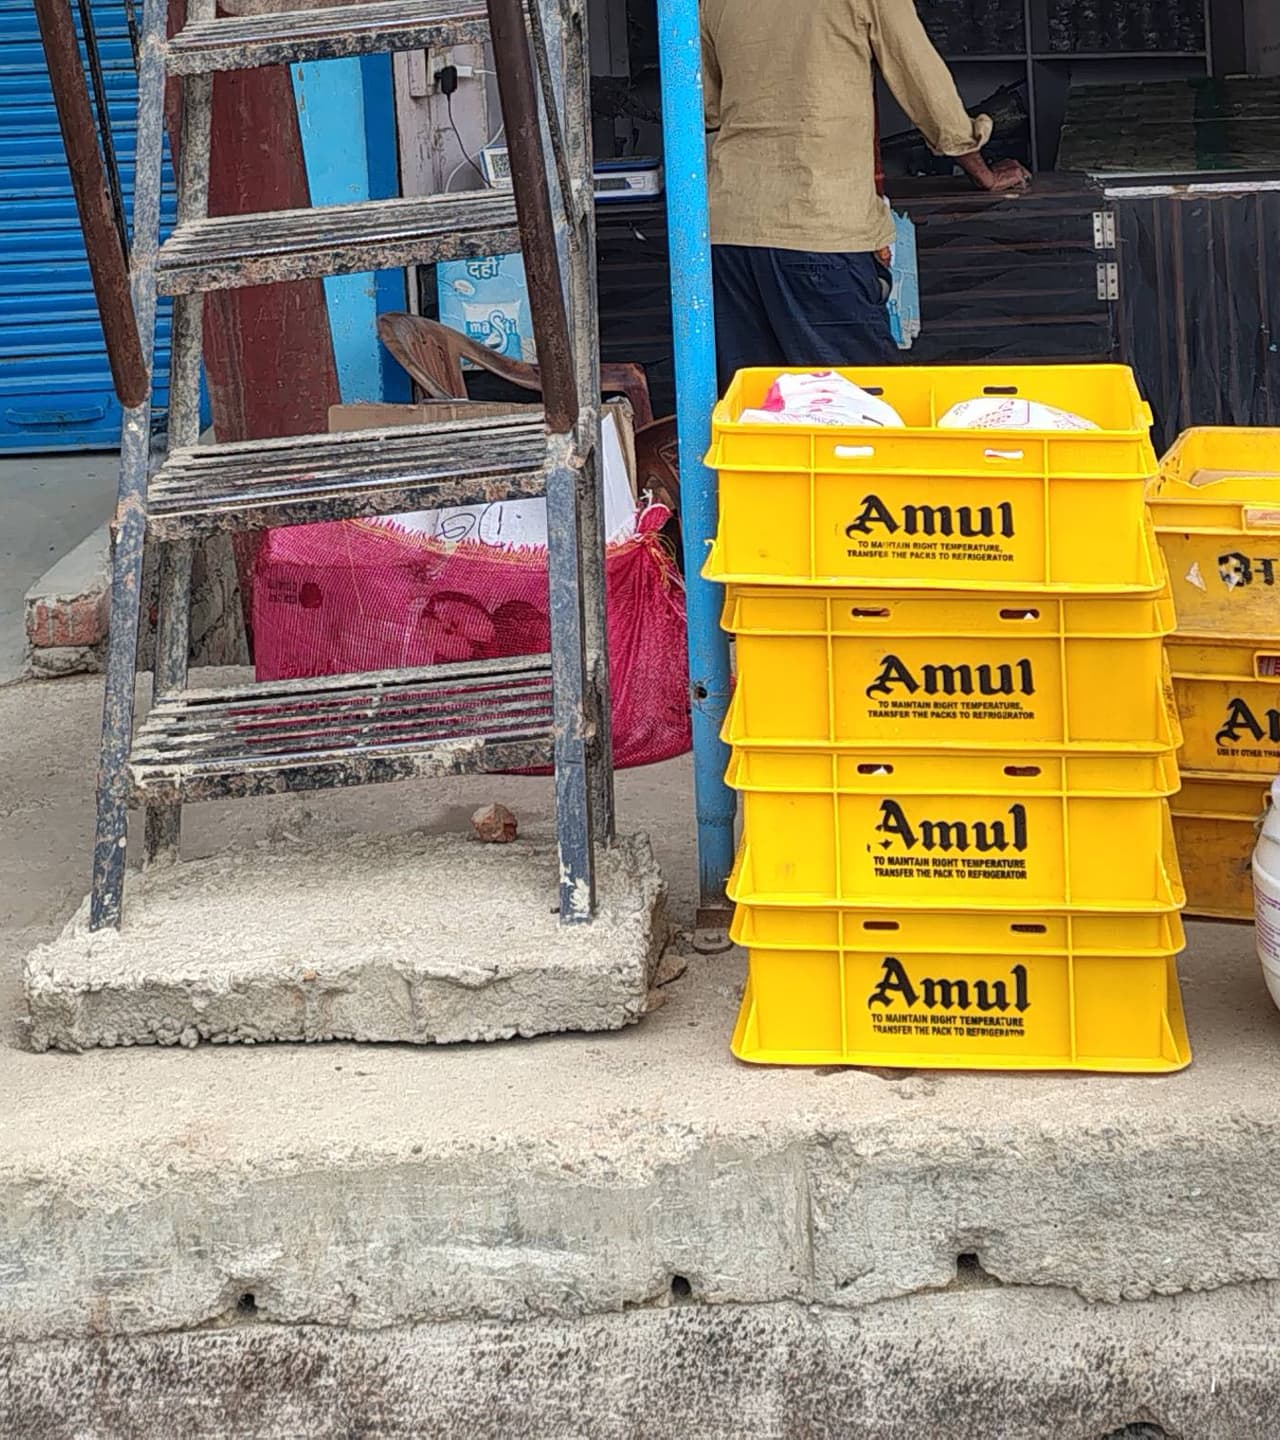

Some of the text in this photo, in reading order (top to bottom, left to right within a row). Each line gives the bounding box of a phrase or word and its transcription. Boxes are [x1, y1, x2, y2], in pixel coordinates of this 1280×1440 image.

[845, 494, 1015, 539] Amul
[858, 540, 869, 548] TO
[913, 542, 938, 550] RIGHT
[892, 550, 907, 558] THE
[910, 551, 936, 559] PACKS
[939, 552, 950, 560] TO
[952, 553, 1014, 562] REFRIGERATOR
[866, 654, 1036, 700] Amul
[867, 799, 1028, 853] Amul
[873, 856, 1025, 868] TO MAINTAIN RIGHT TEMPERATURE
[874, 868, 1027, 880] TRANSFER THE PACK TO REFRIGERATOR
[868, 956, 1032, 1013] Amul
